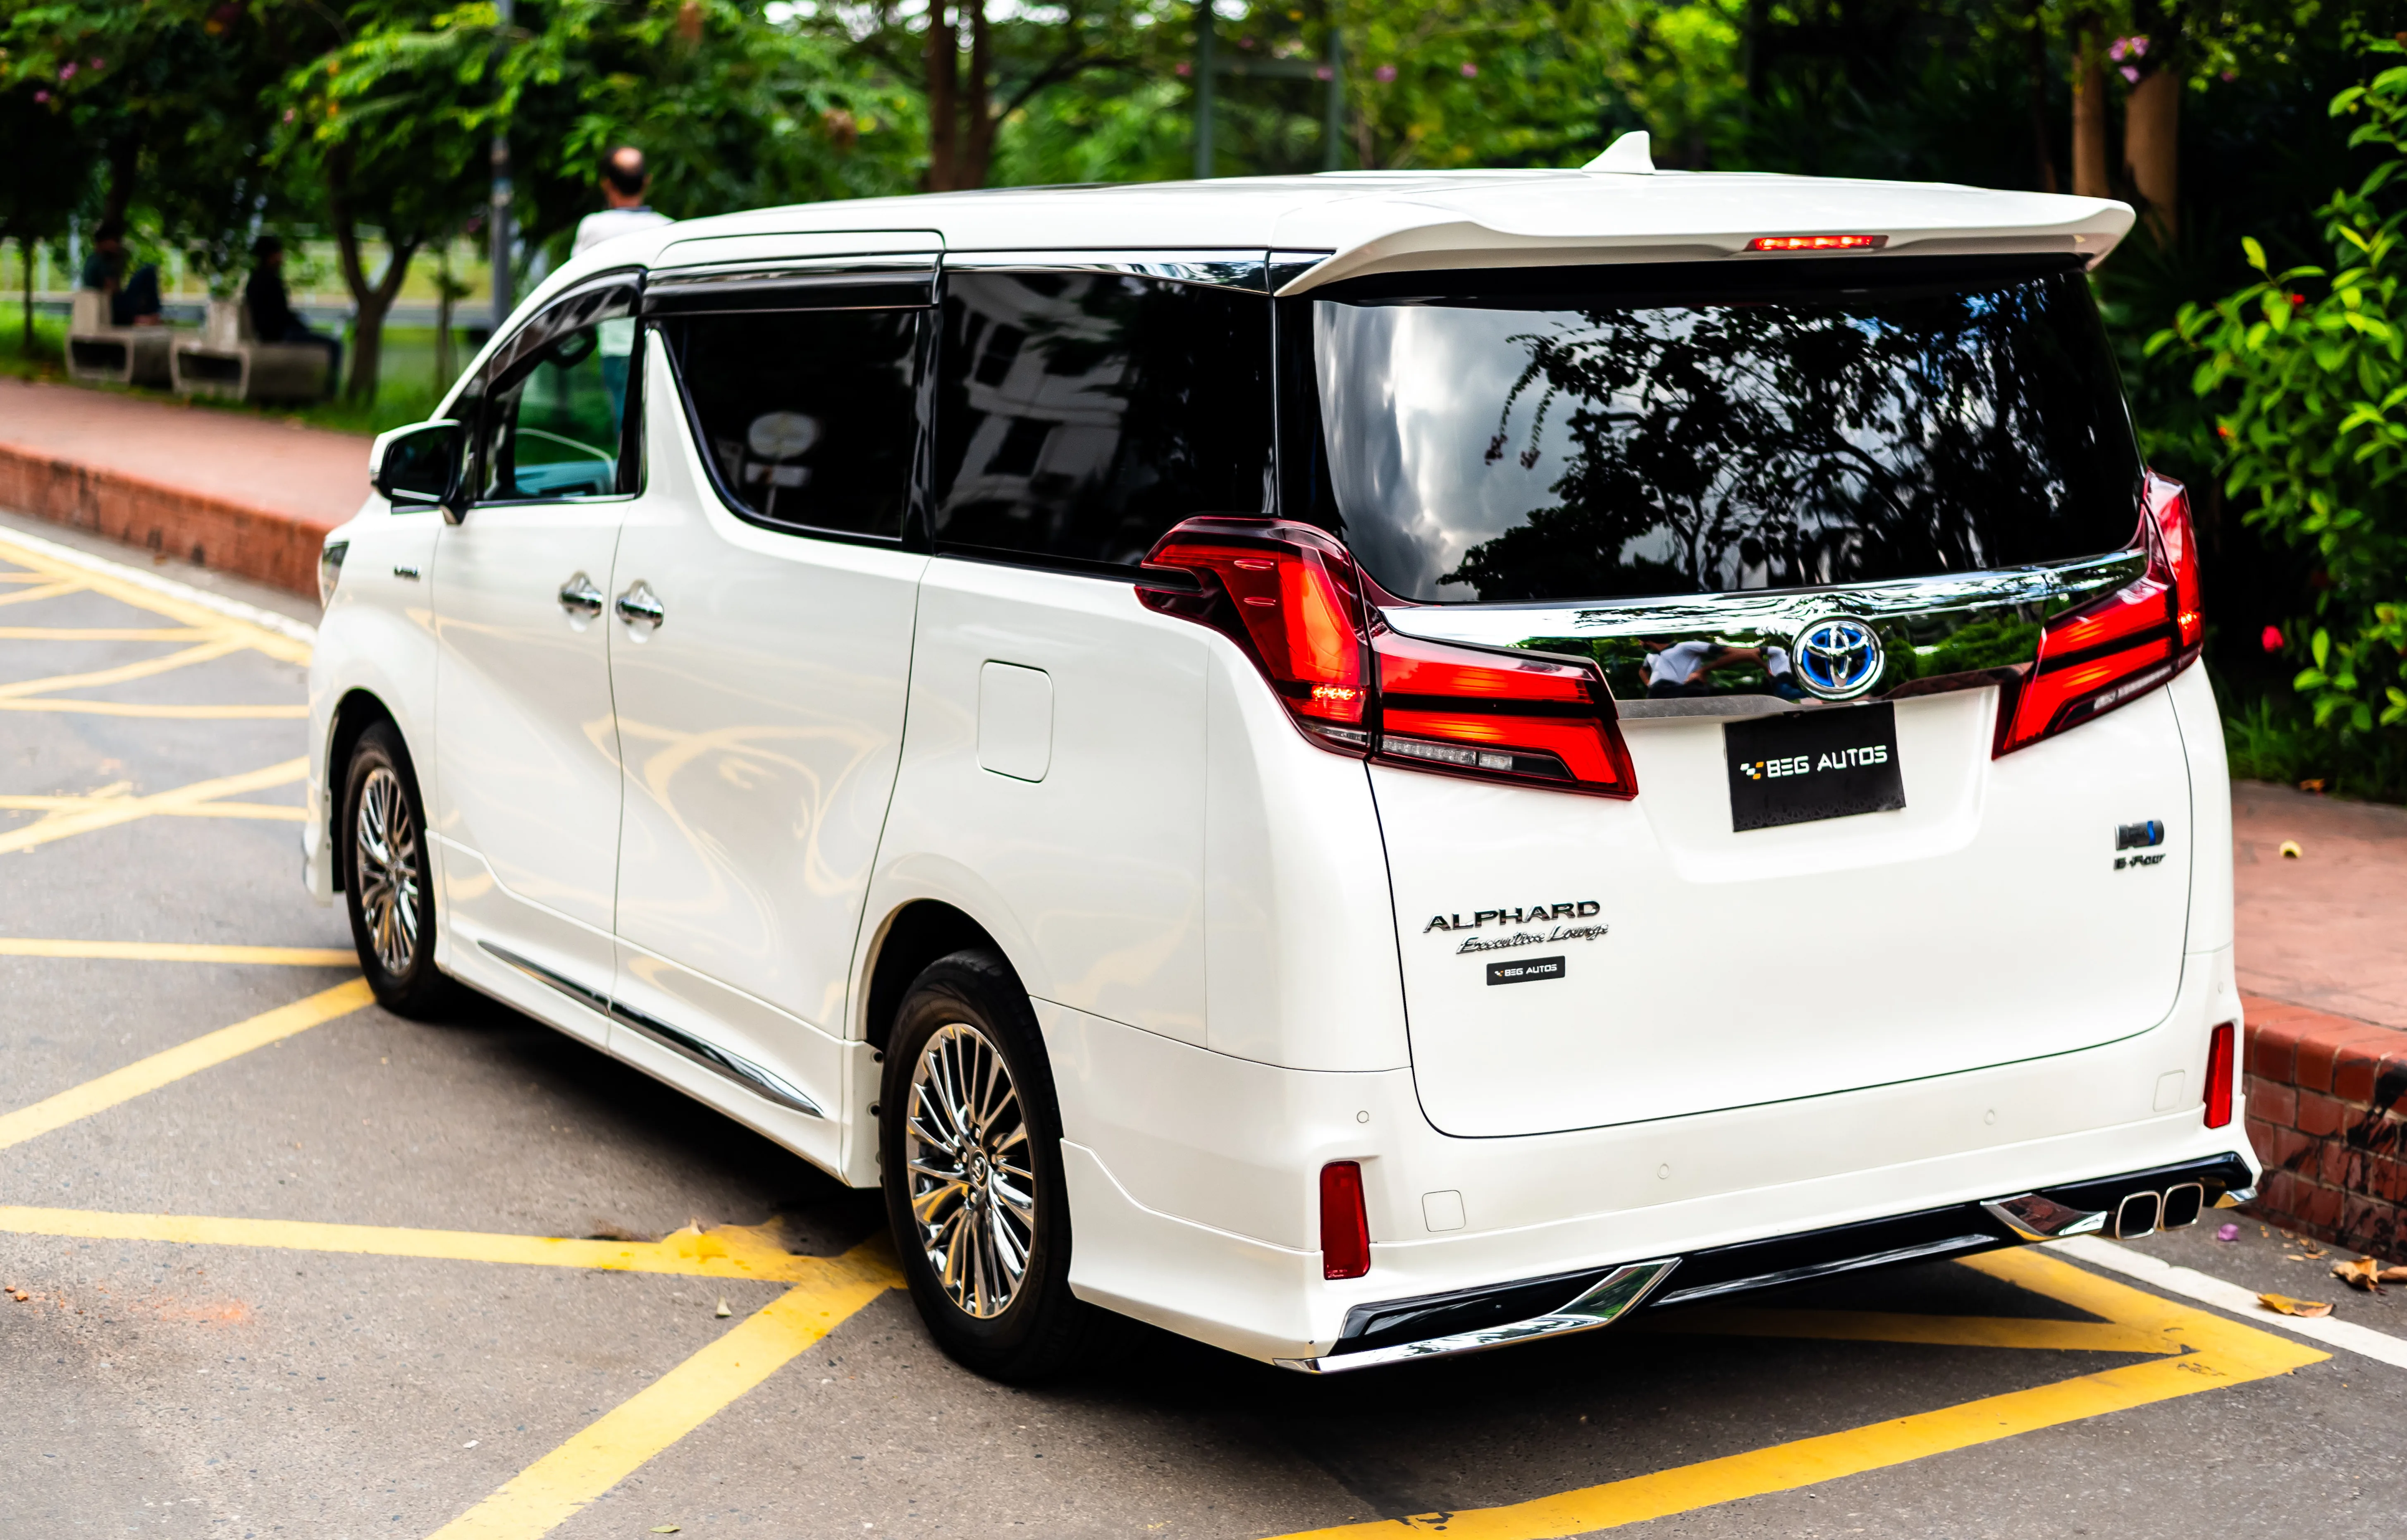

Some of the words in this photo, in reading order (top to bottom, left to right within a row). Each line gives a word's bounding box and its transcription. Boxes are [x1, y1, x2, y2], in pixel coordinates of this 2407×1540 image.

[1767, 756, 1809, 778] BEG
[1817, 745, 1888, 771] AUTOS
[1423, 899, 1600, 933] ALPHARD
[1547, 923, 1609, 942] Lounge
[1504, 967, 1523, 977] BEG
[1526, 964, 1557, 974] AUTOS
